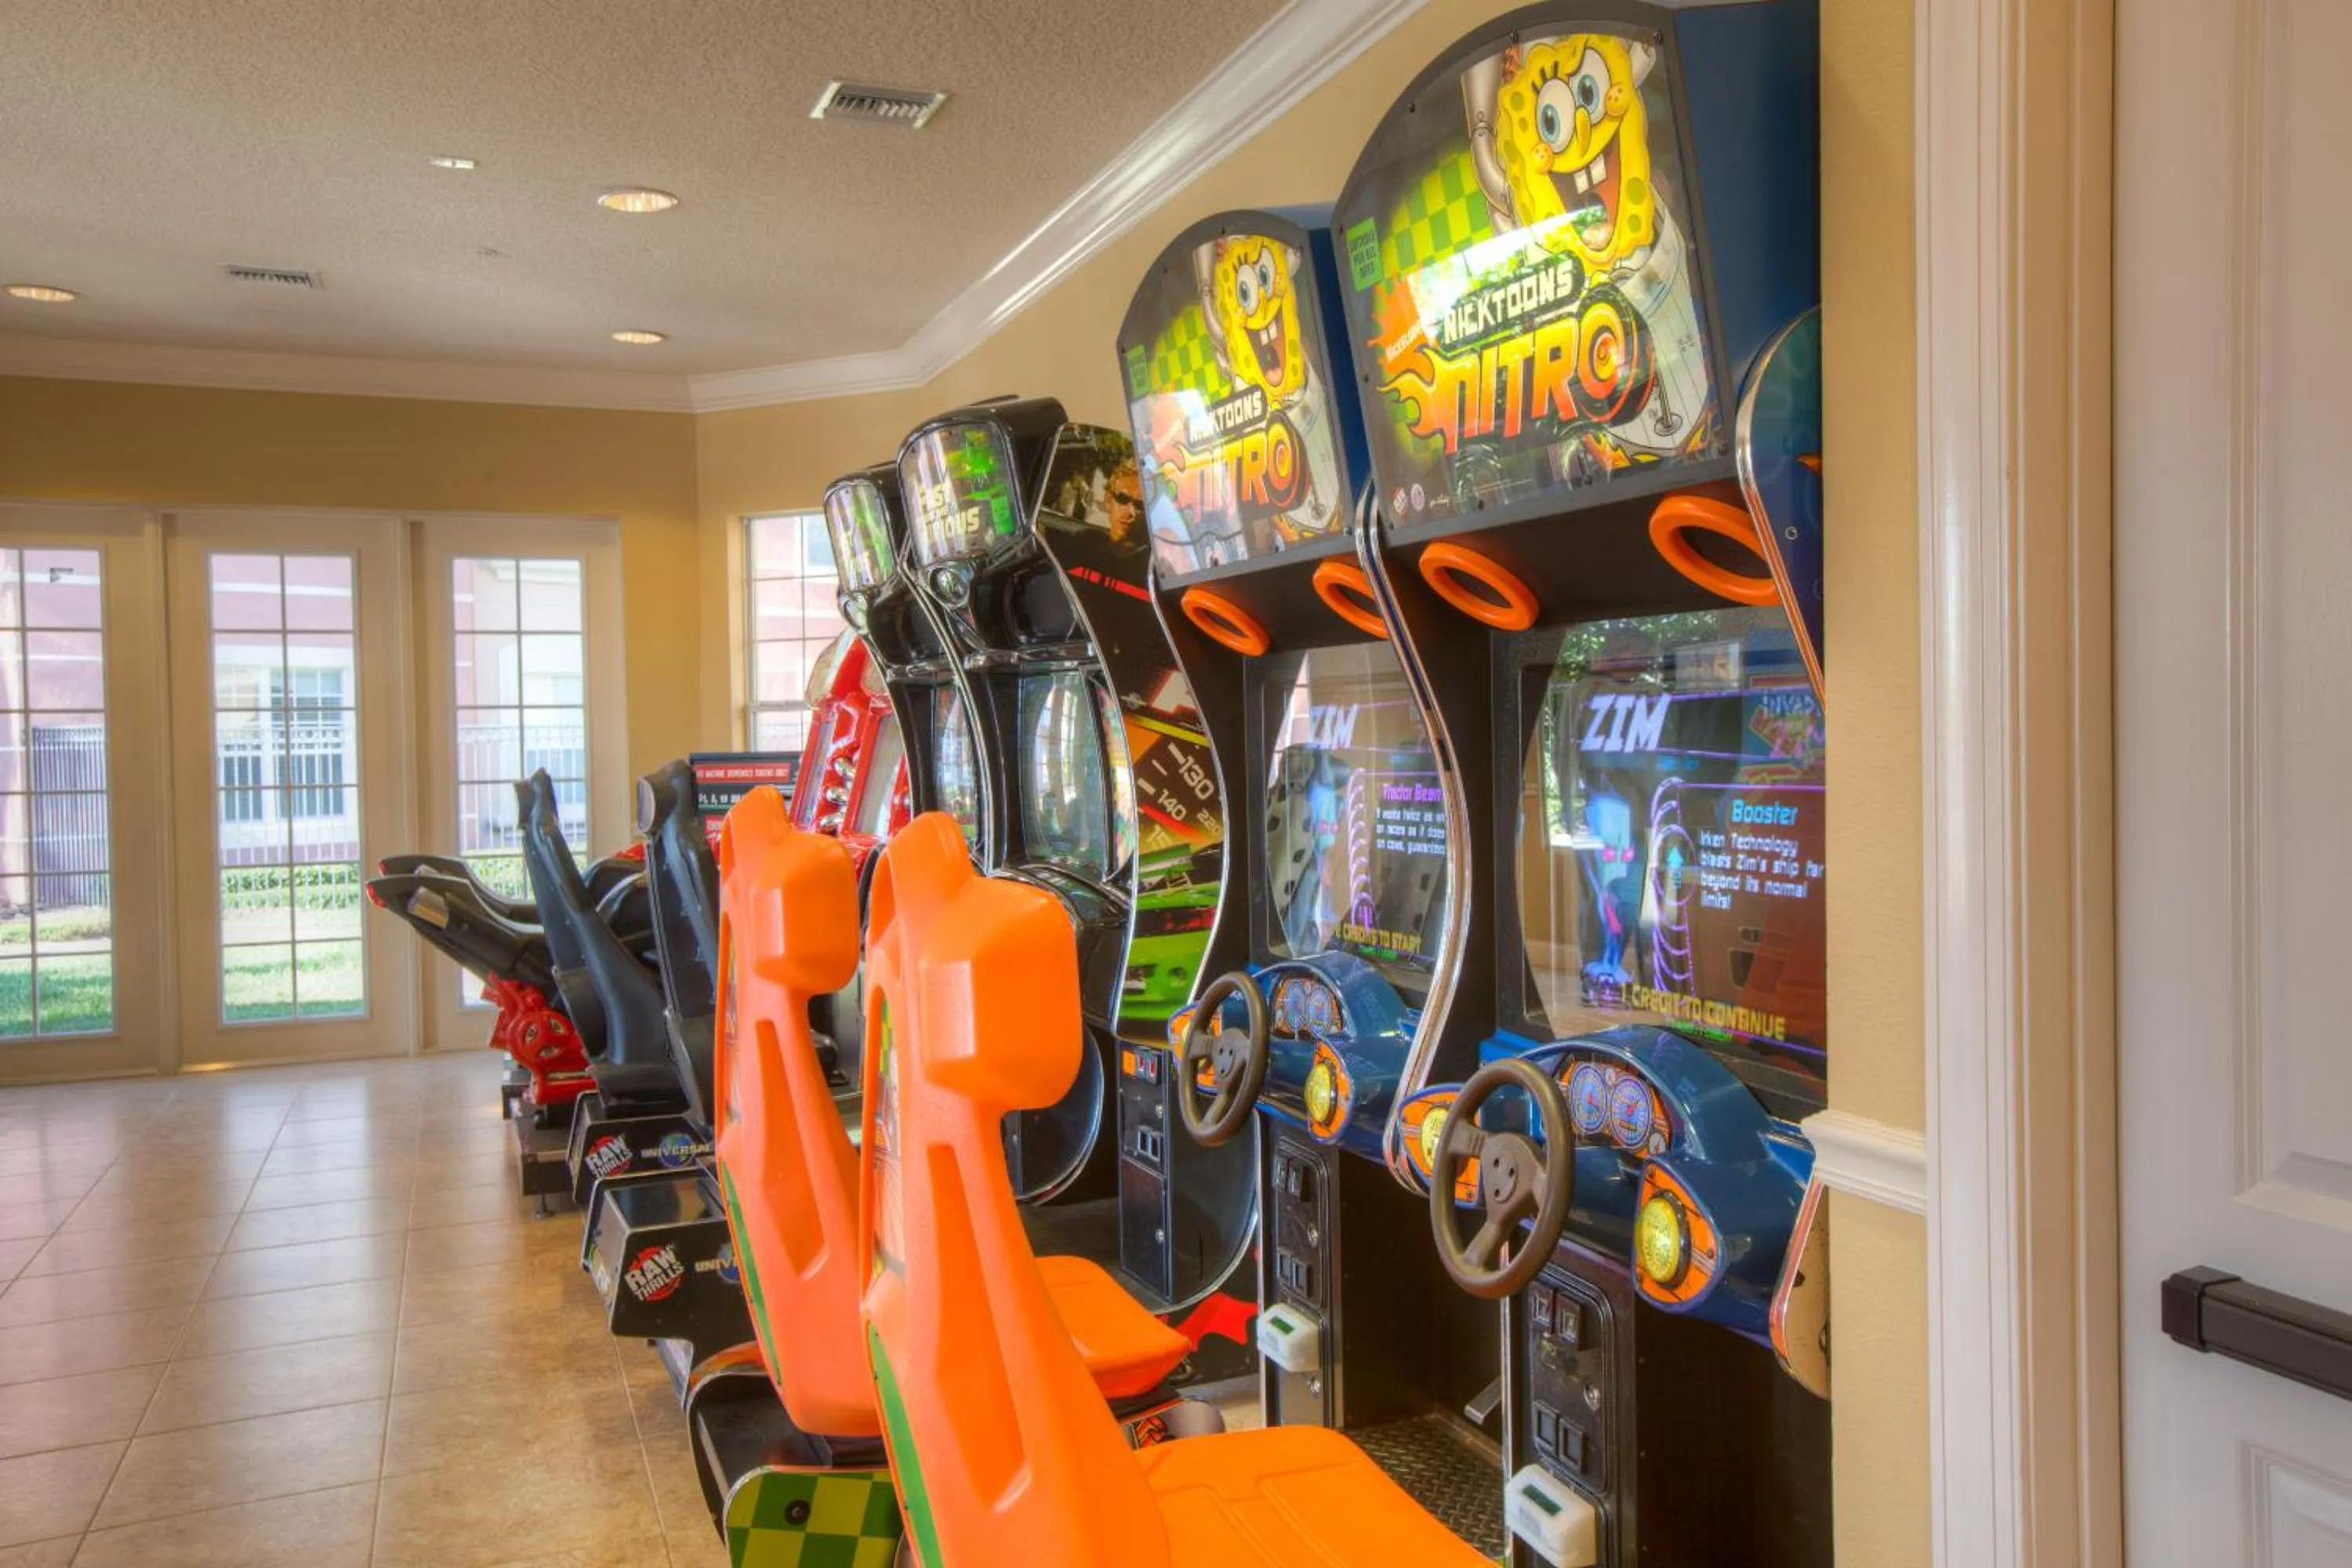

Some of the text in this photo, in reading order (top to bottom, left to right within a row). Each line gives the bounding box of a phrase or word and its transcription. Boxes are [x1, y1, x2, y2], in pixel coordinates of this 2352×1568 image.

[1443, 260, 1573, 345] NICKTOONS
[1377, 302, 1627, 456] NITRO
[1580, 693, 1671, 753] ZIM
[1178, 755, 1214, 800] 130
[1157, 788, 1187, 822] 140
[1730, 799, 1798, 826] Booster
[1731, 832, 1798, 858] Technology
[1736, 854, 1768, 873] Zim's
[1700, 871, 1740, 891] beyond
[1764, 879, 1808, 898] normal
[584, 1135, 628, 1171] RAW
[624, 1247, 678, 1292] RAW
[634, 1261, 684, 1301] THRILLS
[695, 1257, 737, 1272] UNIV
